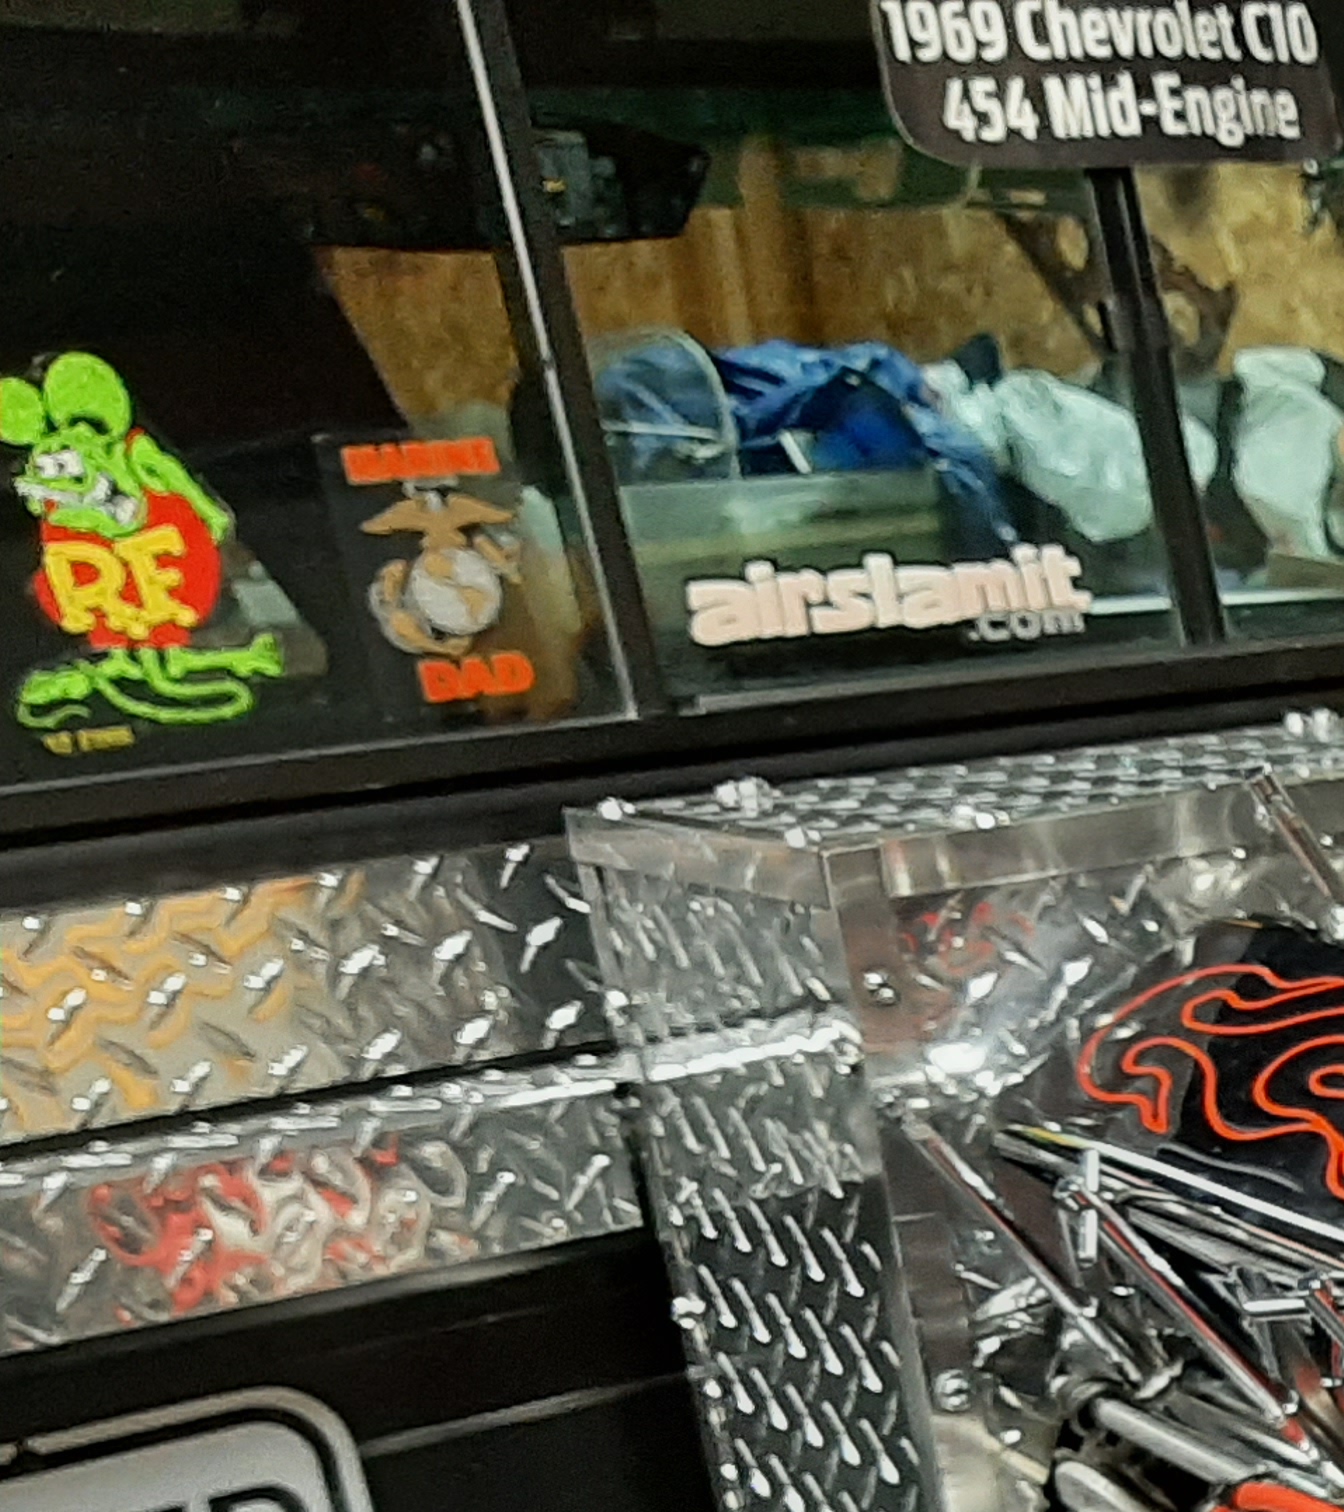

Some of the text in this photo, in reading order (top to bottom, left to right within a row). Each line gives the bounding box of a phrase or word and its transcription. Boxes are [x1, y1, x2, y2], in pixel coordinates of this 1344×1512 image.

[879, 0, 1319, 65] 1969 Chevrolet C10
[942, 69, 1301, 148] 454 Mid-Engine
[687, 543, 1093, 647] airslamit
[969, 610, 1086, 643] .com
[418, 650, 537, 704] DAD
